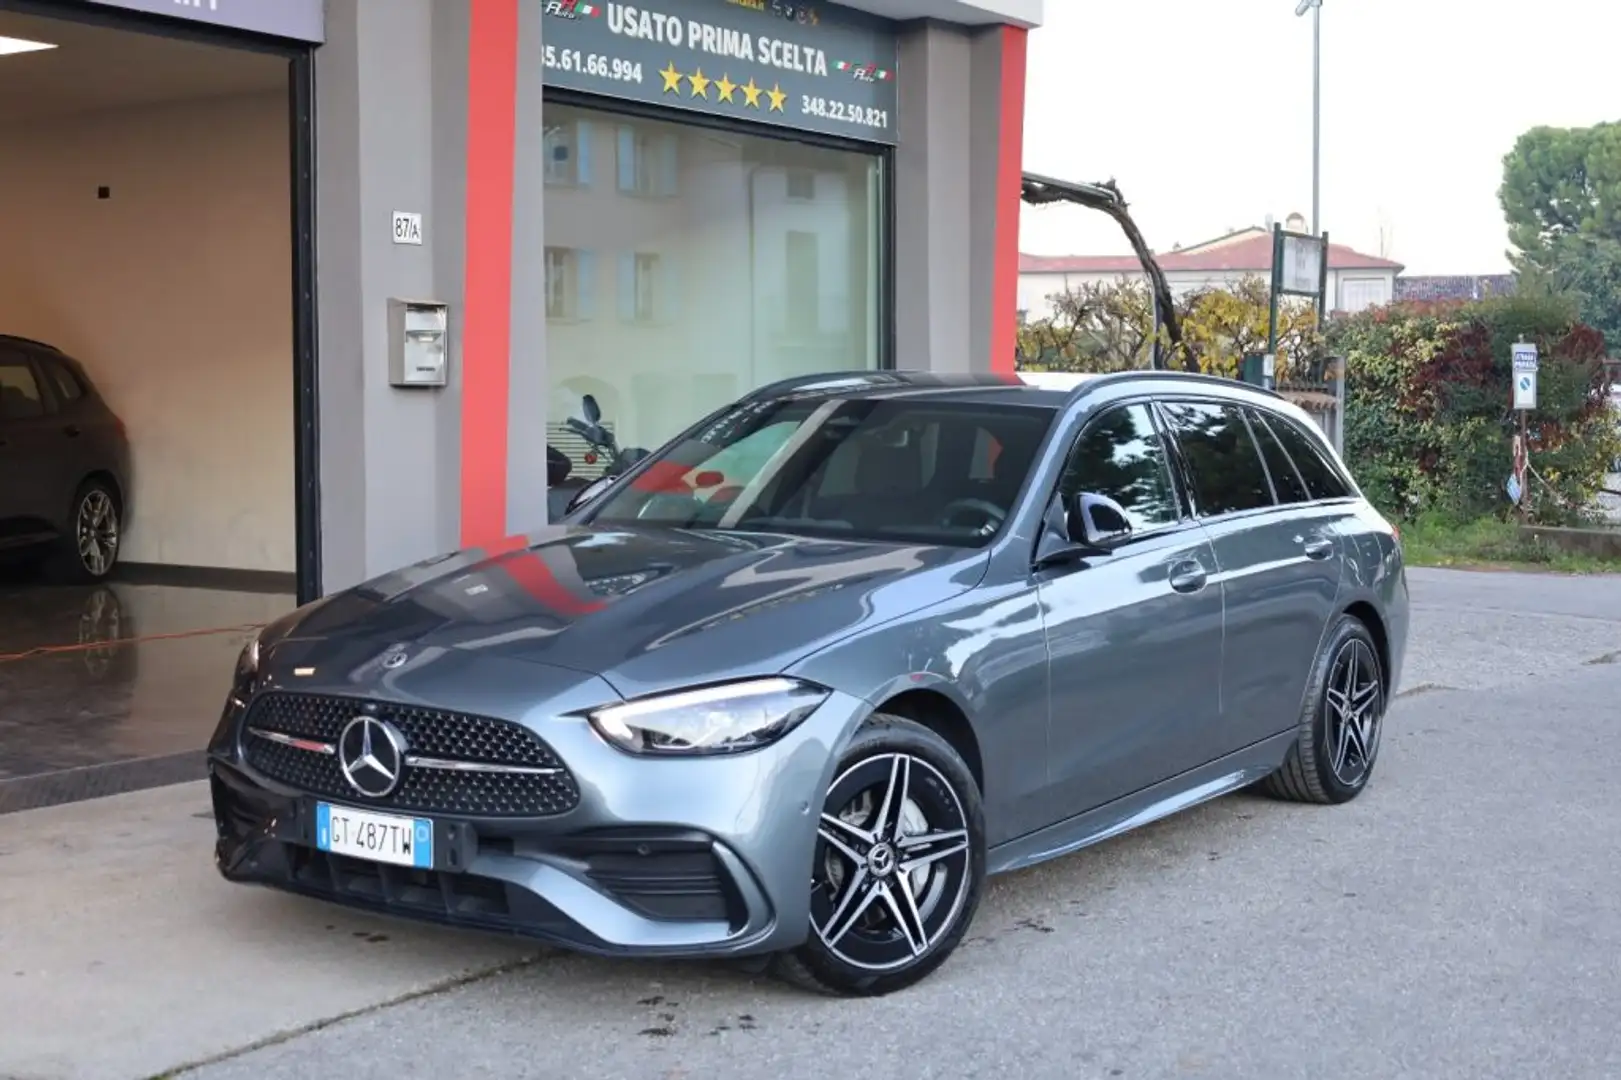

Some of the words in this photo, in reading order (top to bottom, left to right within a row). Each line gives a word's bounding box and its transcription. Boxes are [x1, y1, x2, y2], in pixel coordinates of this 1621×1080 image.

[607, 3, 684, 46] USATO
[688, 21, 754, 61] PRIMA
[758, 36, 828, 76] SCELTA
[801, 95, 888, 128] 348.22.50.821
[396, 217, 420, 239] 87/A
[356, 822, 412, 855] 487TW
